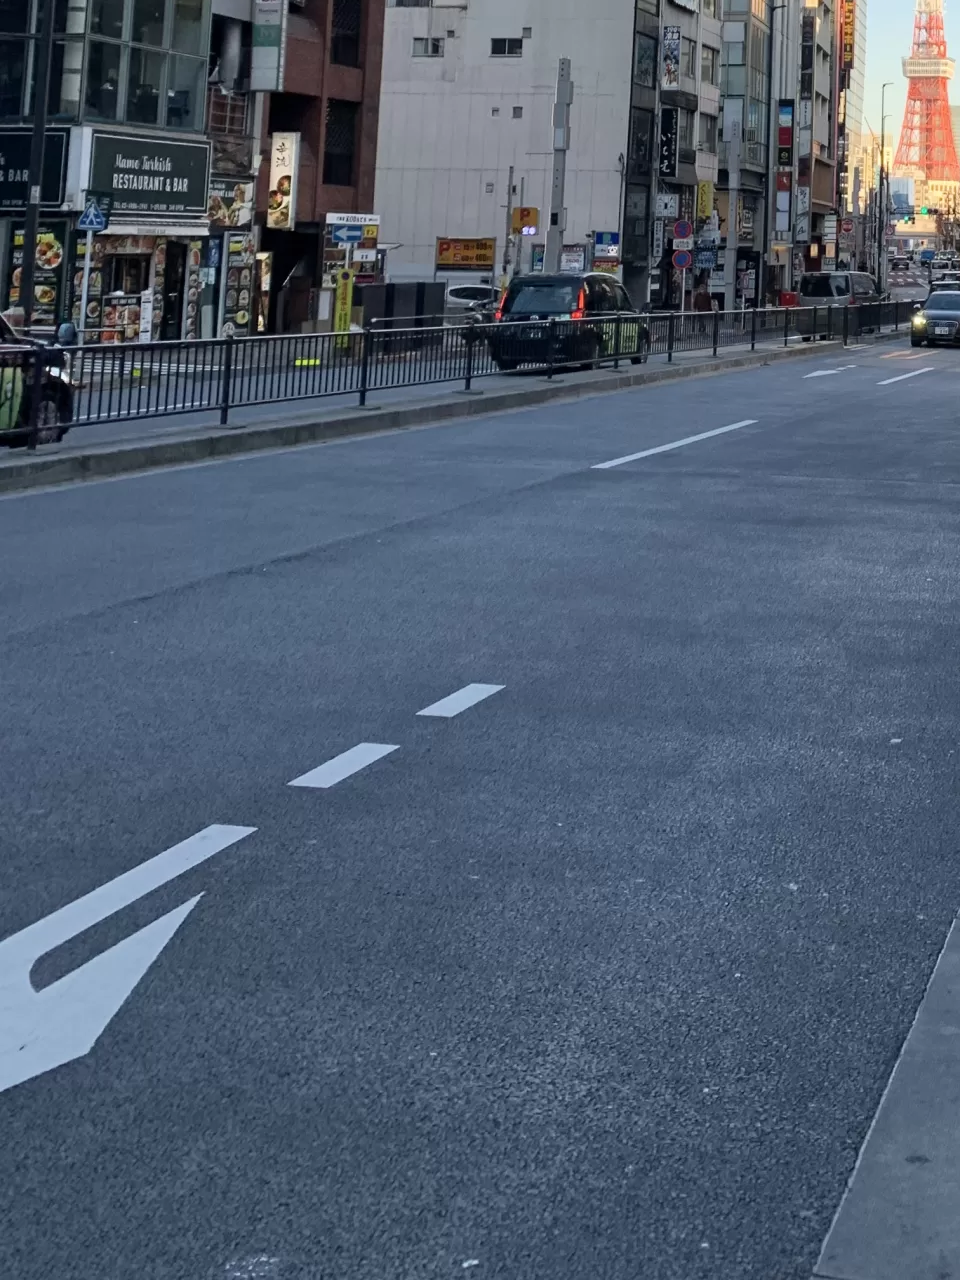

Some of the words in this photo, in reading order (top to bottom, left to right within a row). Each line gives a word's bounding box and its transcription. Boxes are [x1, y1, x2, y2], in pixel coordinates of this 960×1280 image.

[8, 169, 29, 182] BAR
[113, 174, 164, 192] RESTAURANT
[165, 180, 171, 191] &
[173, 178, 188, 192] BAR
[439, 241, 451, 257] P
